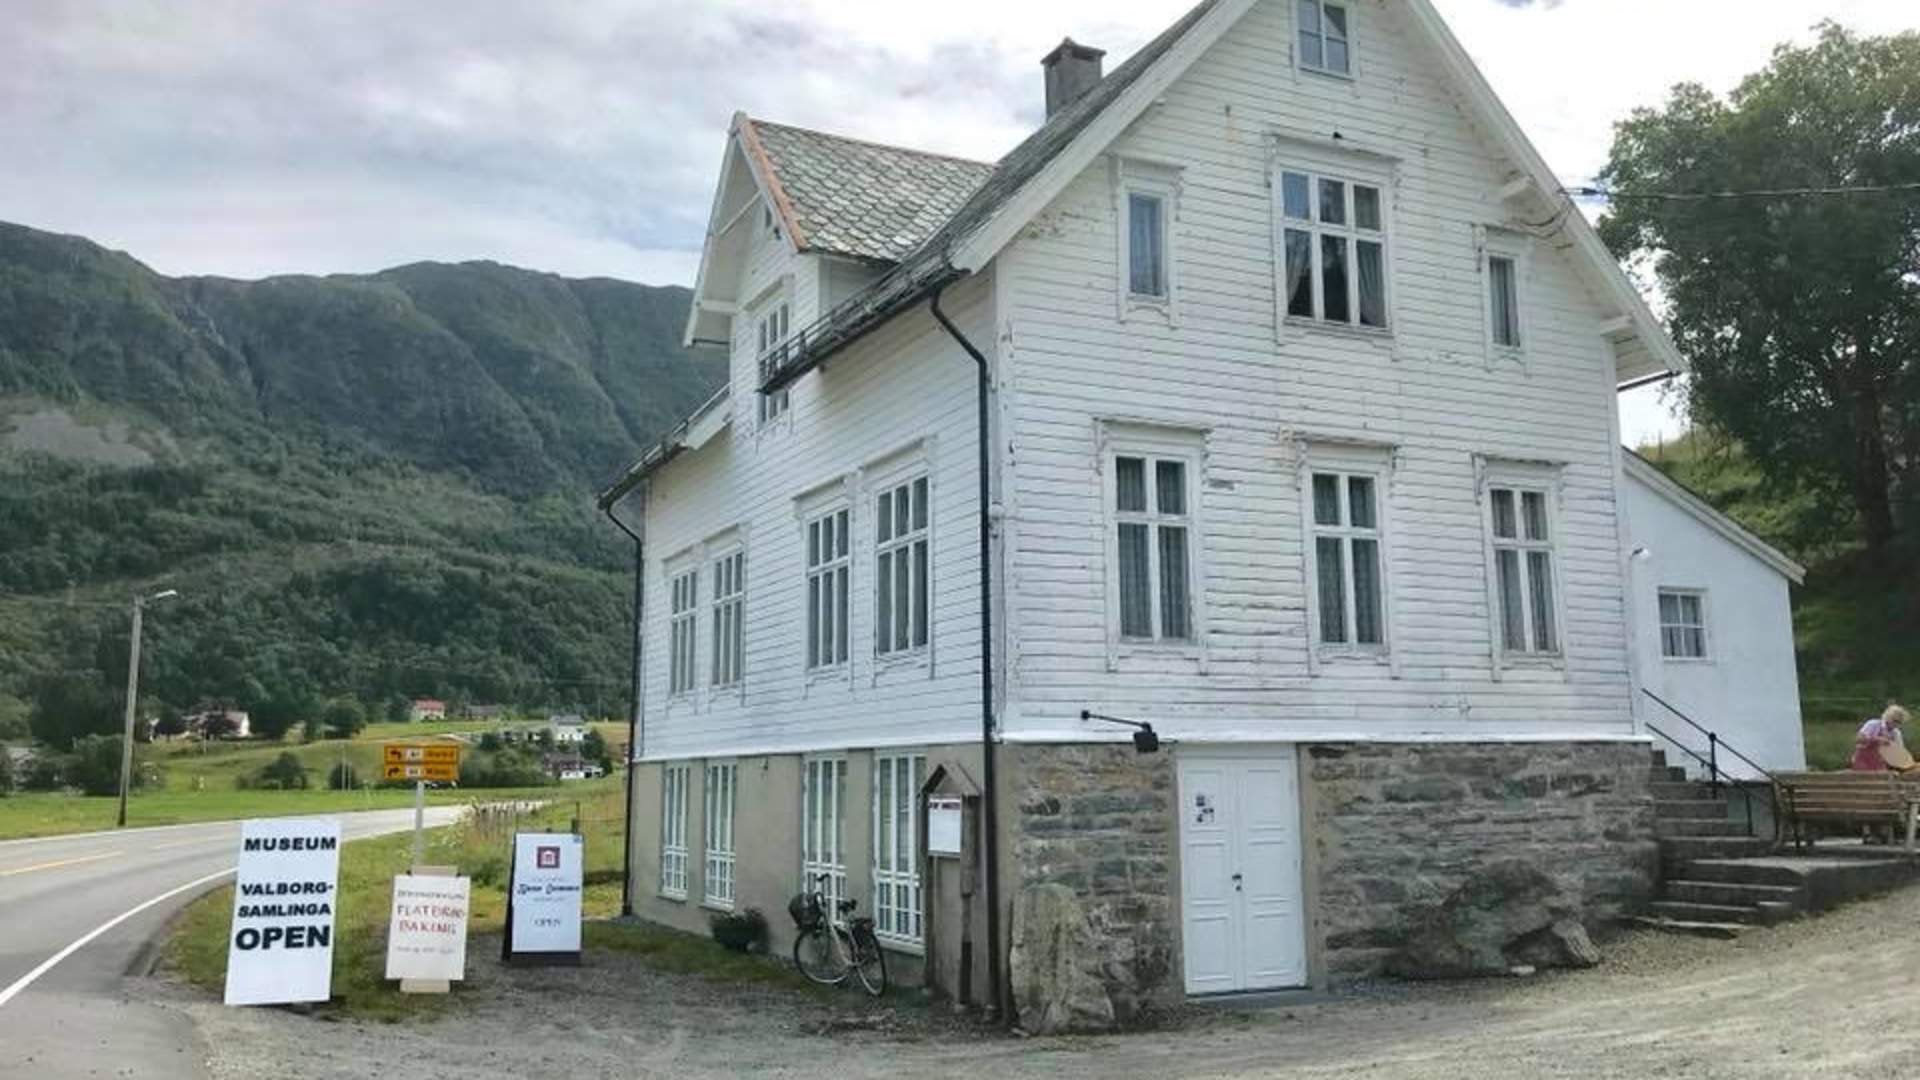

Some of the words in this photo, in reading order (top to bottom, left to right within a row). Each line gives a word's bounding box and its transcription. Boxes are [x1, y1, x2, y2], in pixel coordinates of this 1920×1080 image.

[244, 837, 337, 851] MUSEUM
[241, 881, 334, 896] VALBORG-
[238, 903, 332, 918] SAMLINGA
[235, 925, 331, 951] OPEN
